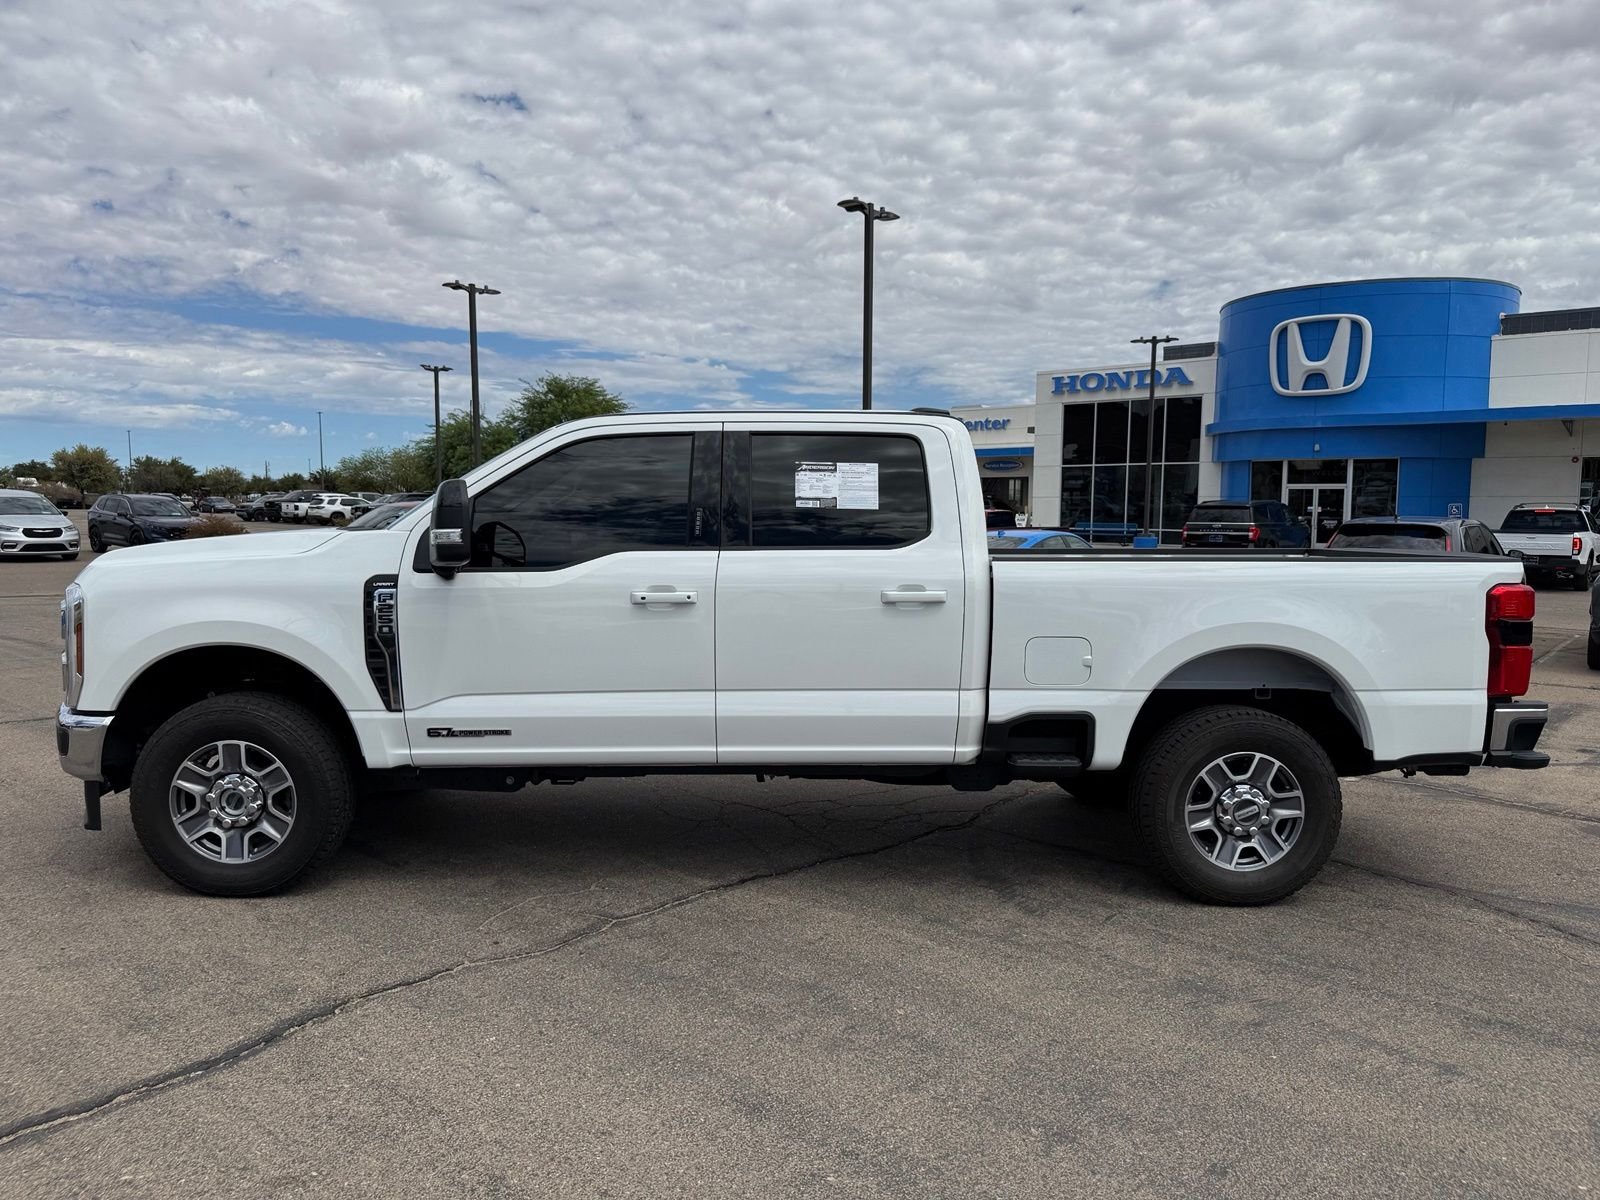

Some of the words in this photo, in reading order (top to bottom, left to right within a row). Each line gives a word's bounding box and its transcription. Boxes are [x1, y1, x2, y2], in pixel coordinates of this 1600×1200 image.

[1051, 366, 1194, 394] HONDA
[957, 417, 1011, 431] enter
[459, 729, 483, 737] POWER
